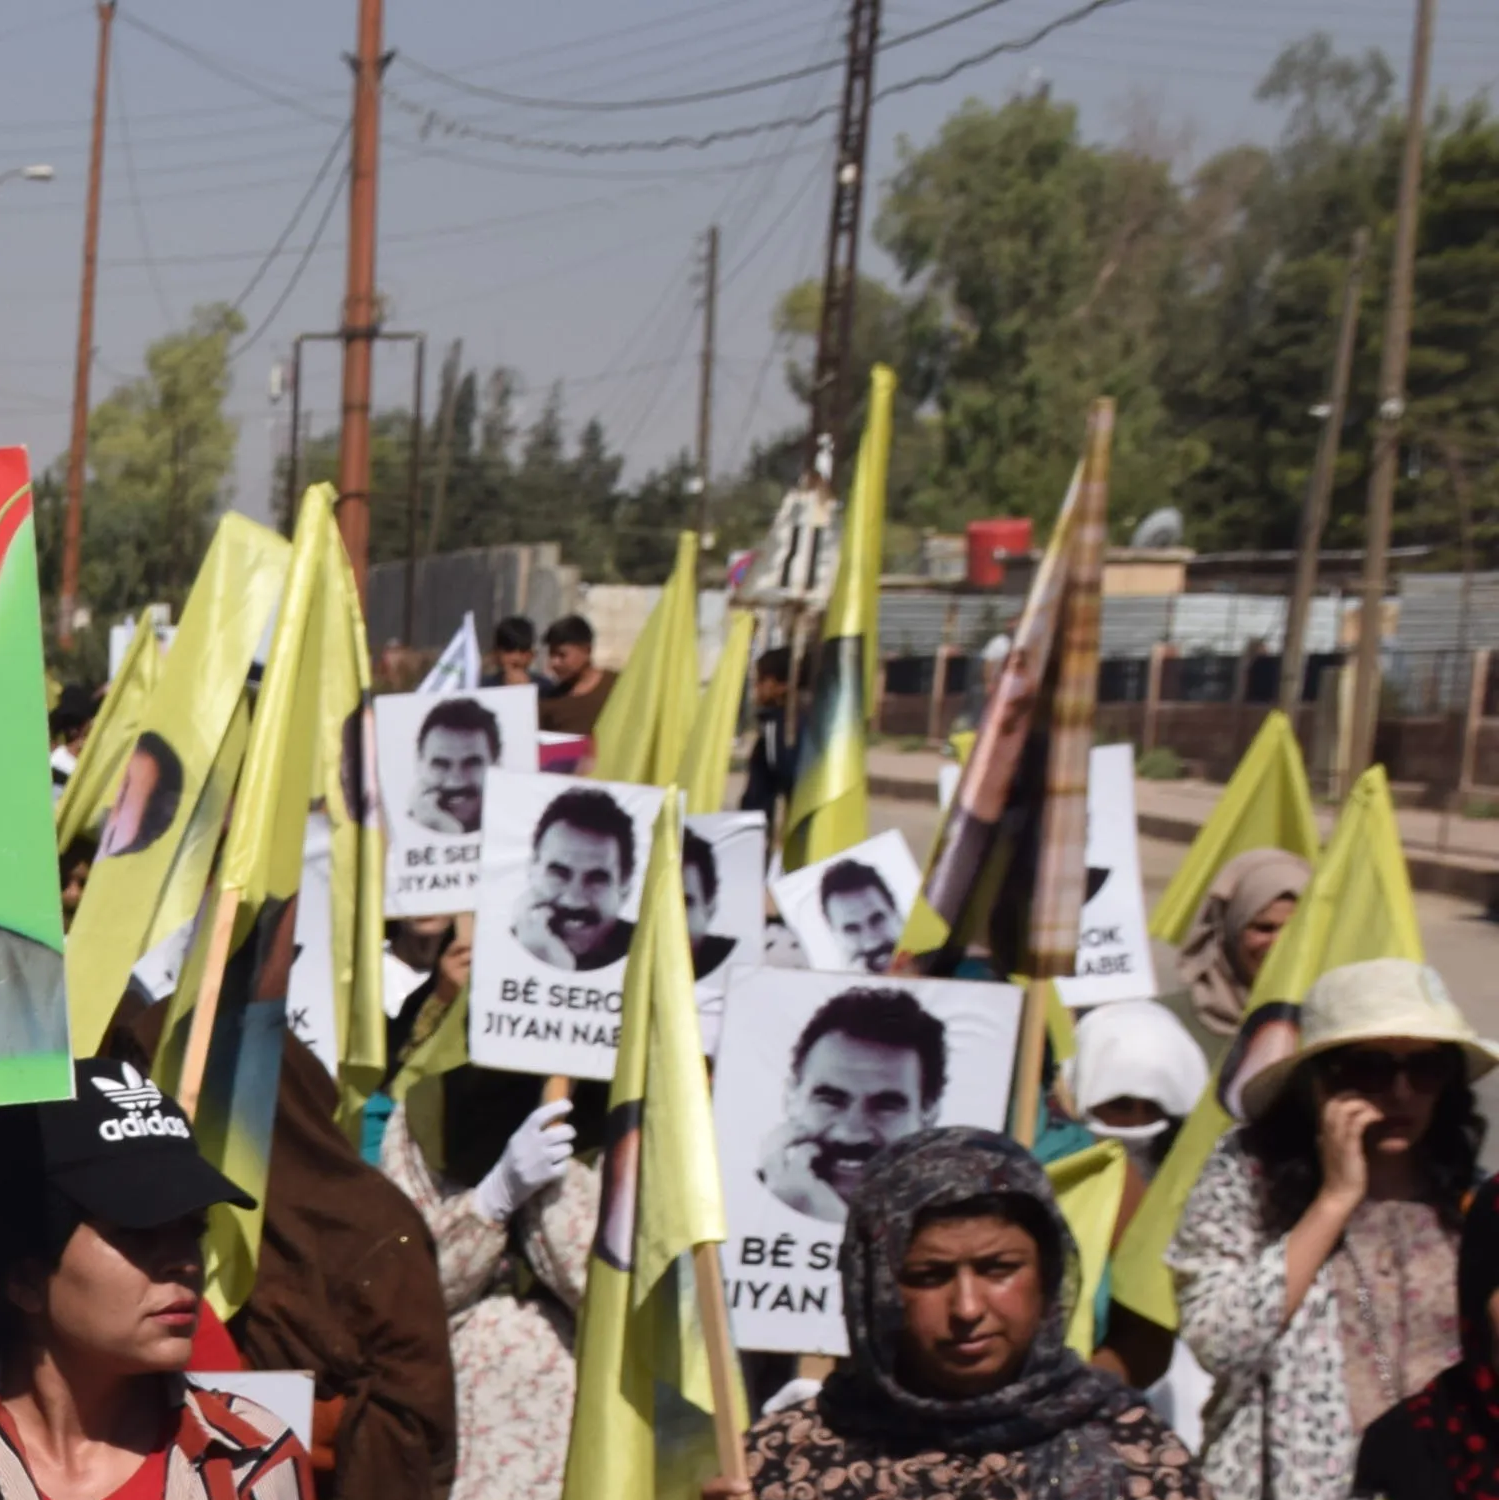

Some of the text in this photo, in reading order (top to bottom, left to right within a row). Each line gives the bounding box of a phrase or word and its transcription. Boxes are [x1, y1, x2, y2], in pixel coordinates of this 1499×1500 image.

[548, 985, 623, 1014] SERO
[484, 1012, 562, 1042] JIYAN
[99, 1109, 190, 1141] adidas
[740, 1232, 797, 1268] BÊ
[724, 1280, 828, 1314] IYAN
